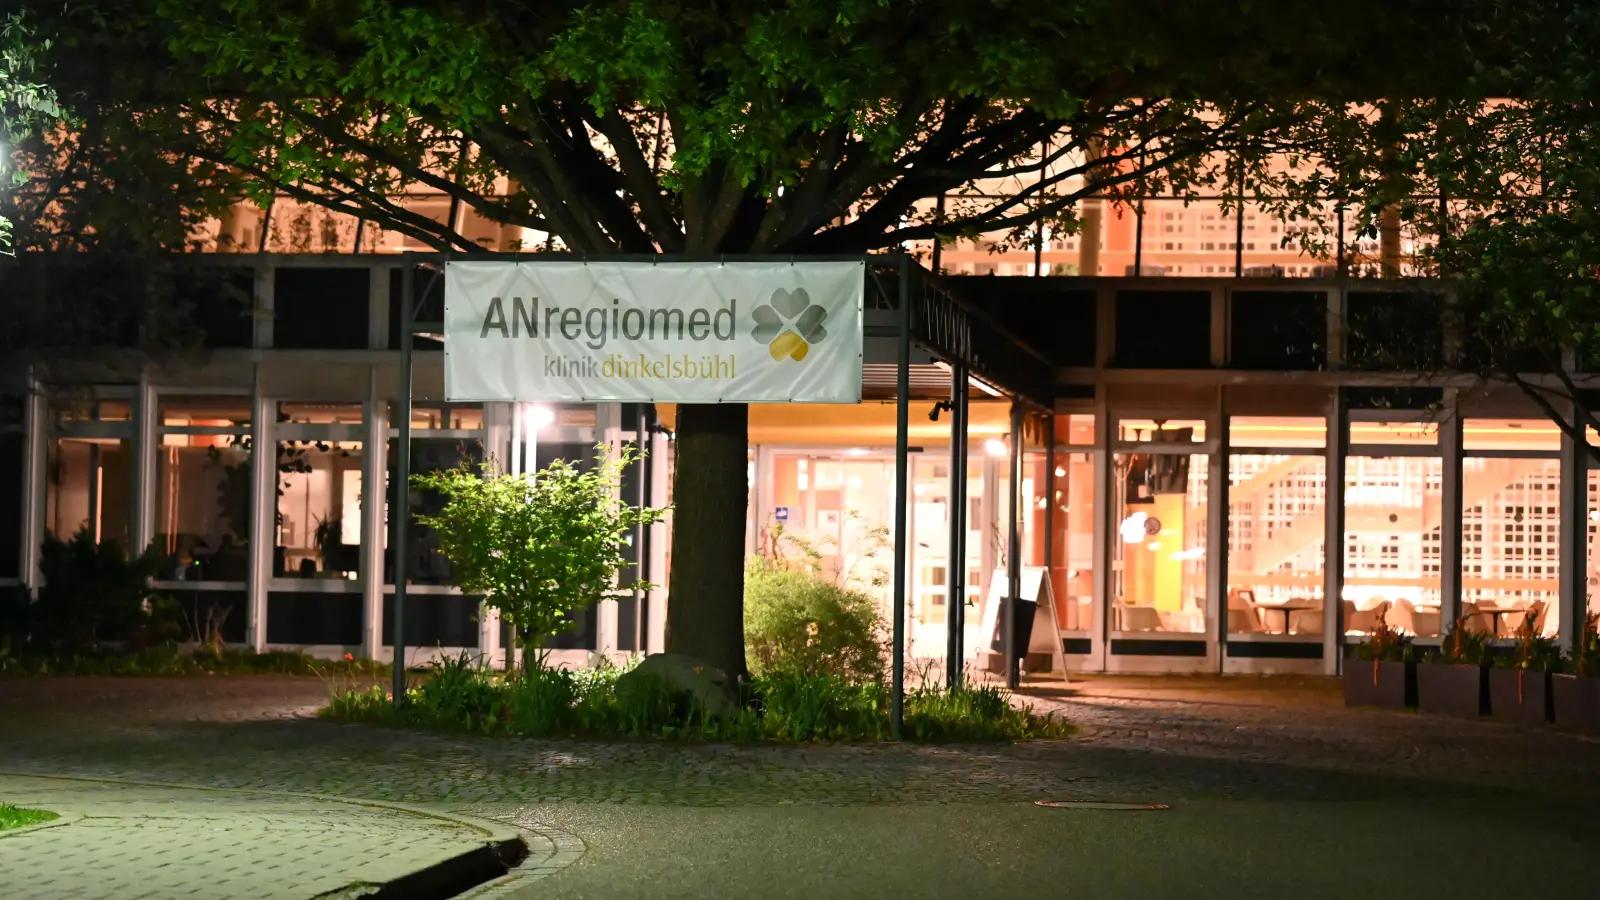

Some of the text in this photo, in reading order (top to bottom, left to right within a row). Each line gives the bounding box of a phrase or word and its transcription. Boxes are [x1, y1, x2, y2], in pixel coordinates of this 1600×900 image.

[480, 297, 736, 350] ANregiomed
[544, 353, 736, 379] klinik dinkelsbühl
